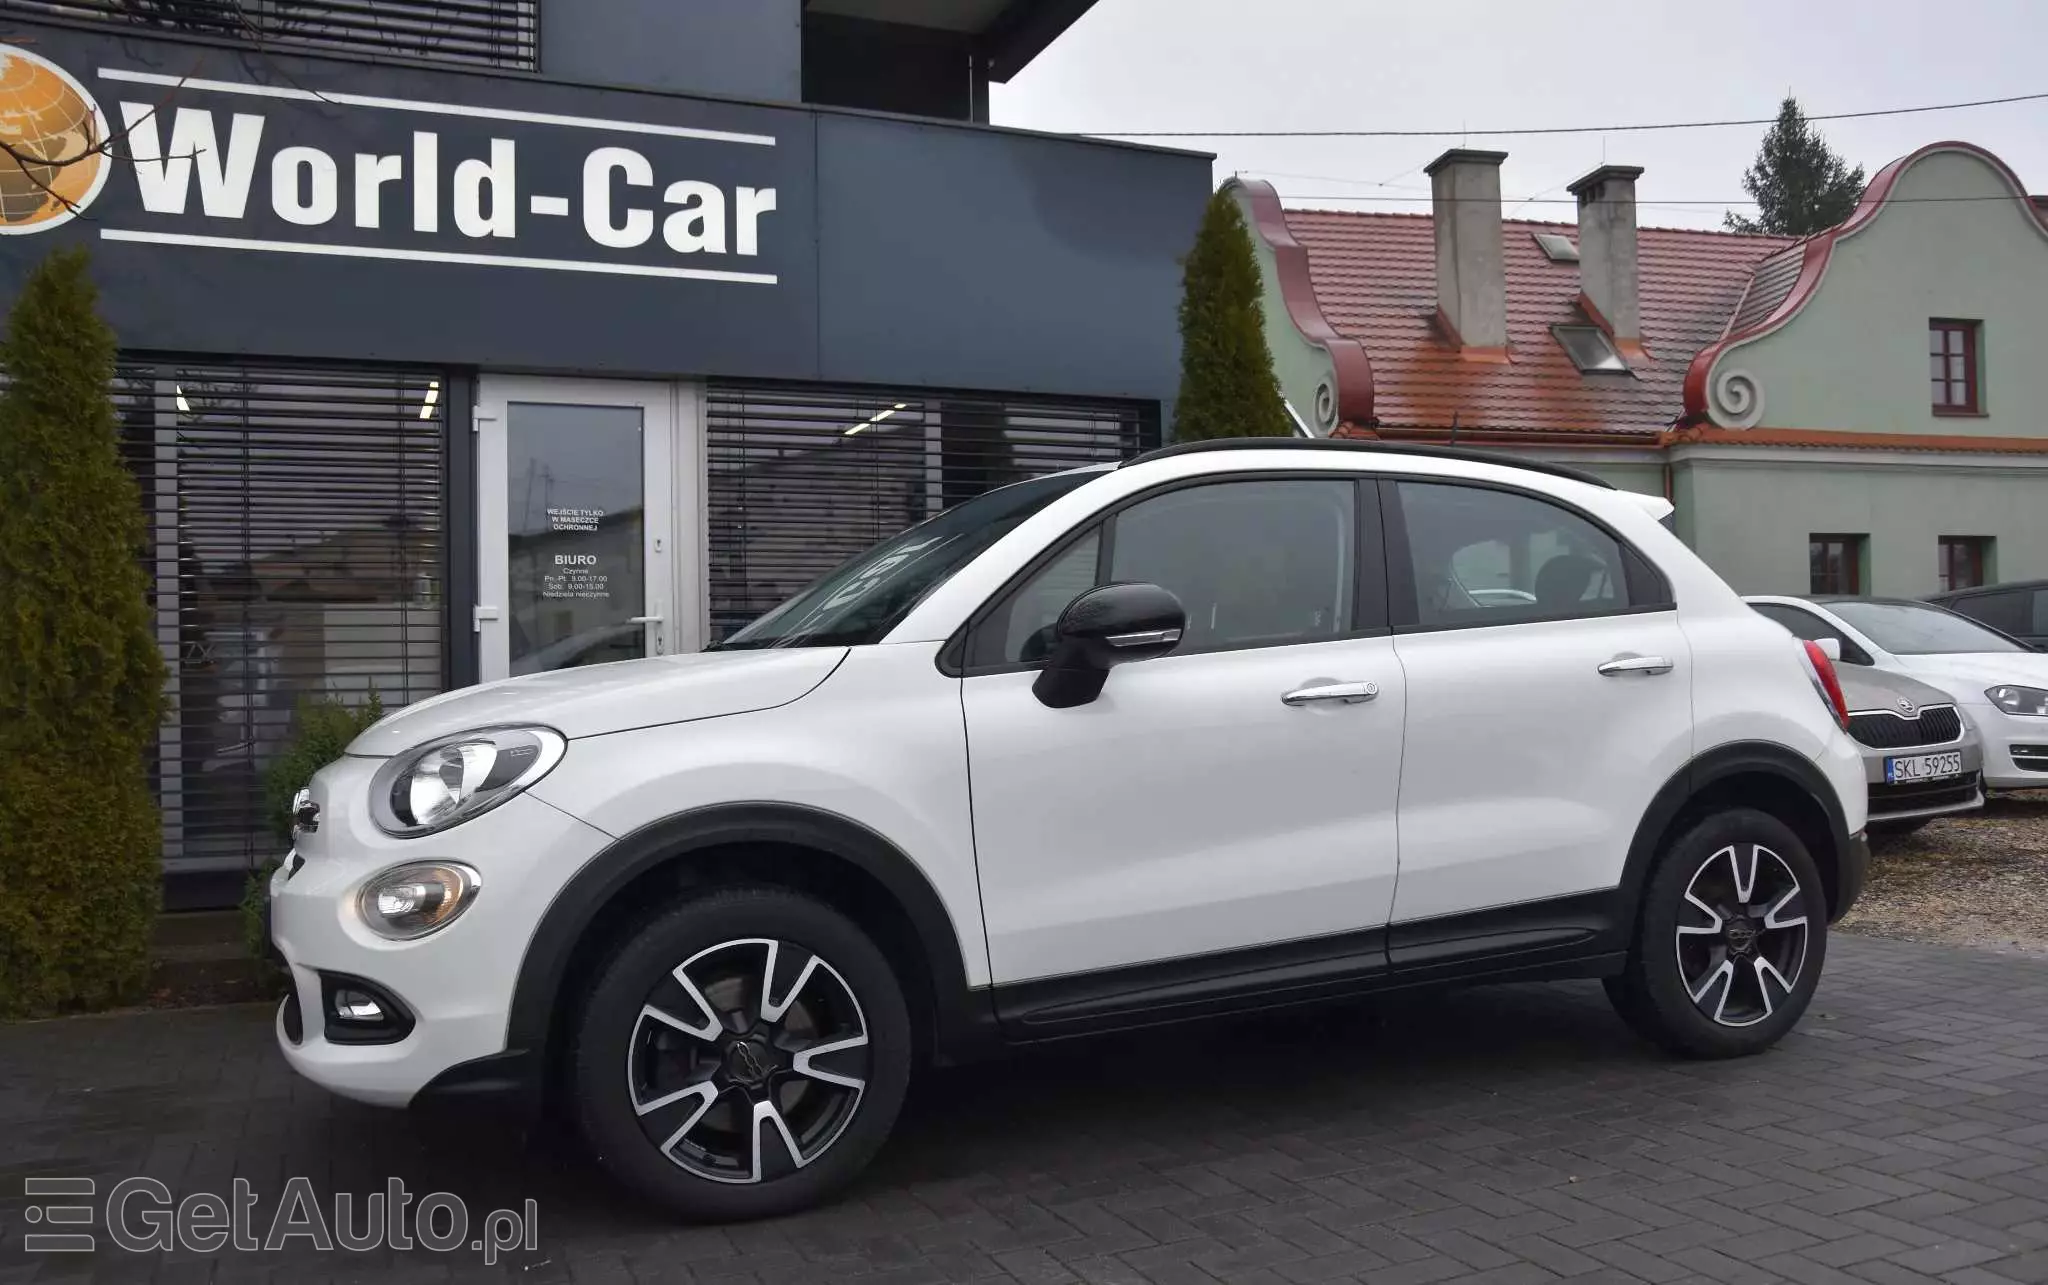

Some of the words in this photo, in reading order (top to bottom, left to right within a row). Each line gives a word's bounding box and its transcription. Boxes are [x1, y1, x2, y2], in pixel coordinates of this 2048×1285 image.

[119, 102, 776, 256] World-Car
[580, 509, 603, 517] TYLKO
[554, 555, 596, 565] BIURO
[1895, 759, 1921, 778] SKL
[1924, 754, 1960, 775] 59255
